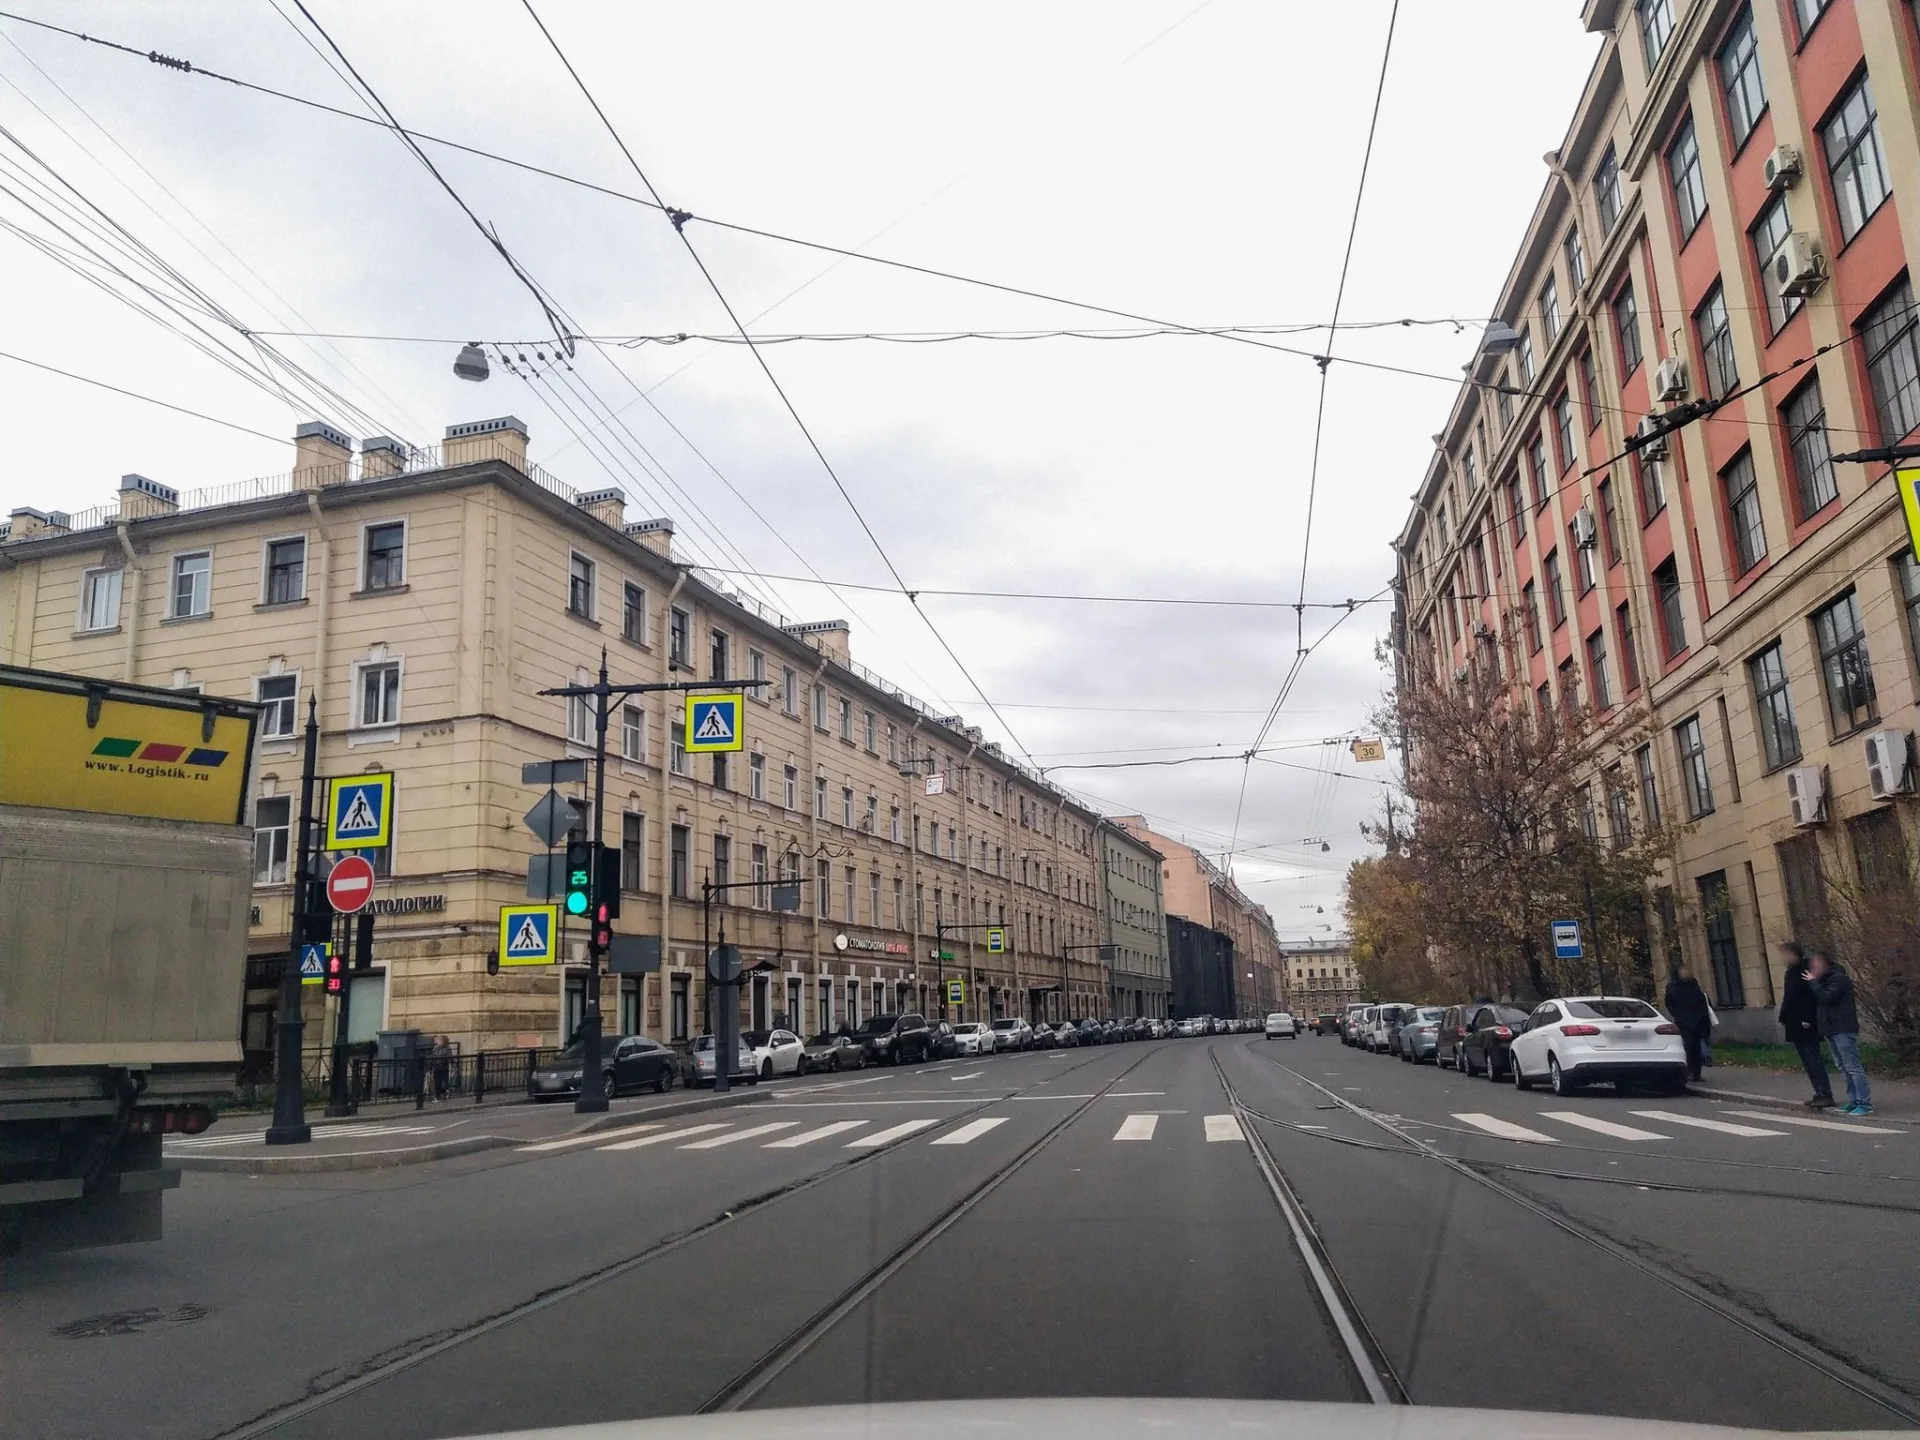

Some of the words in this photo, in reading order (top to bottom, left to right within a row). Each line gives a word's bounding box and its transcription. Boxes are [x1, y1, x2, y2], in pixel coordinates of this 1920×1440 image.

[1362, 748, 1374, 756] 30
[571, 871, 588, 885] 25
[328, 978, 340, 990] 30
